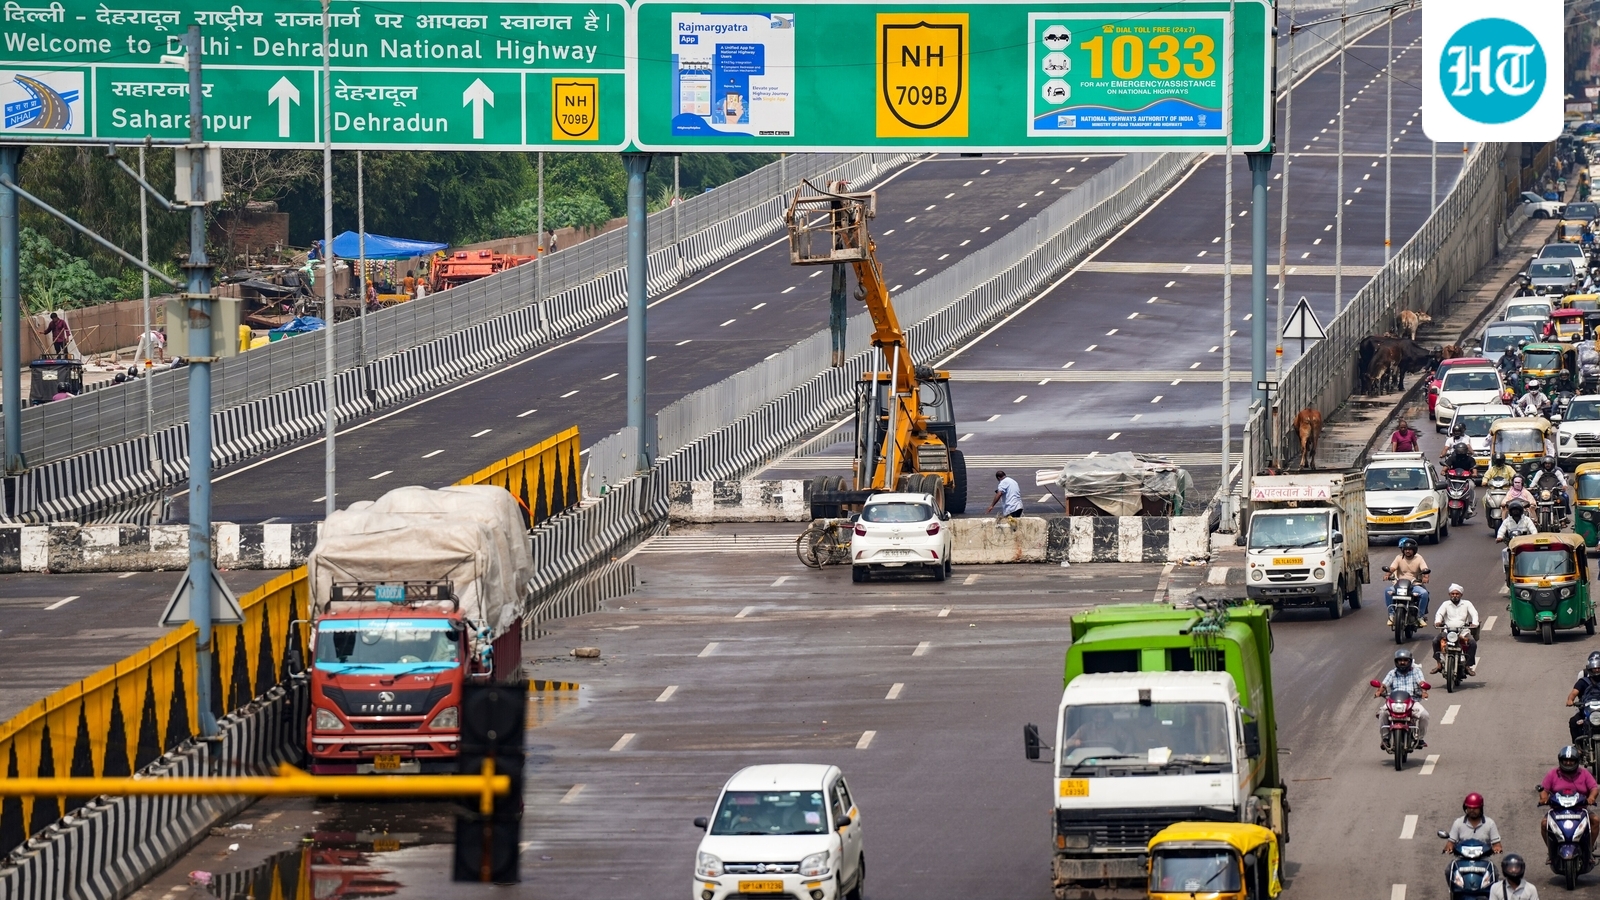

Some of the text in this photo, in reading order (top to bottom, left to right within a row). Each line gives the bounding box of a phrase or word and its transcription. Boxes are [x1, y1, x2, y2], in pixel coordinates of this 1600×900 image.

[4, 1, 65, 23] दिल्ली
[95, 2, 181, 31] देहरादून
[194, 5, 263, 32] राष्ट्रीय
[274, 7, 361, 28] राजमार्ग
[375, 14, 404, 29] पर
[416, 15, 488, 30] आपका
[500, 16, 572, 30] स्वागत
[678, 22, 748, 33] Rajmargyatra
[4, 32, 112, 53] Welcome
[126, 35, 151, 53] to
[166, 35, 229, 56] Dlhi
[253, 37, 368, 58] Dehradun
[381, 39, 482, 59] National
[496, 40, 597, 65] Highway
[902, 45, 943, 67] NH
[1080, 35, 1216, 79] 1033
[334, 79, 418, 107] देहरादून
[565, 95, 587, 107] NH
[896, 86, 947, 105] 709B
[10, 111, 31, 125] NHAI
[334, 112, 448, 132] Dehradun
[562, 114, 588, 124] 709B
[361, 704, 412, 712] EICHER
